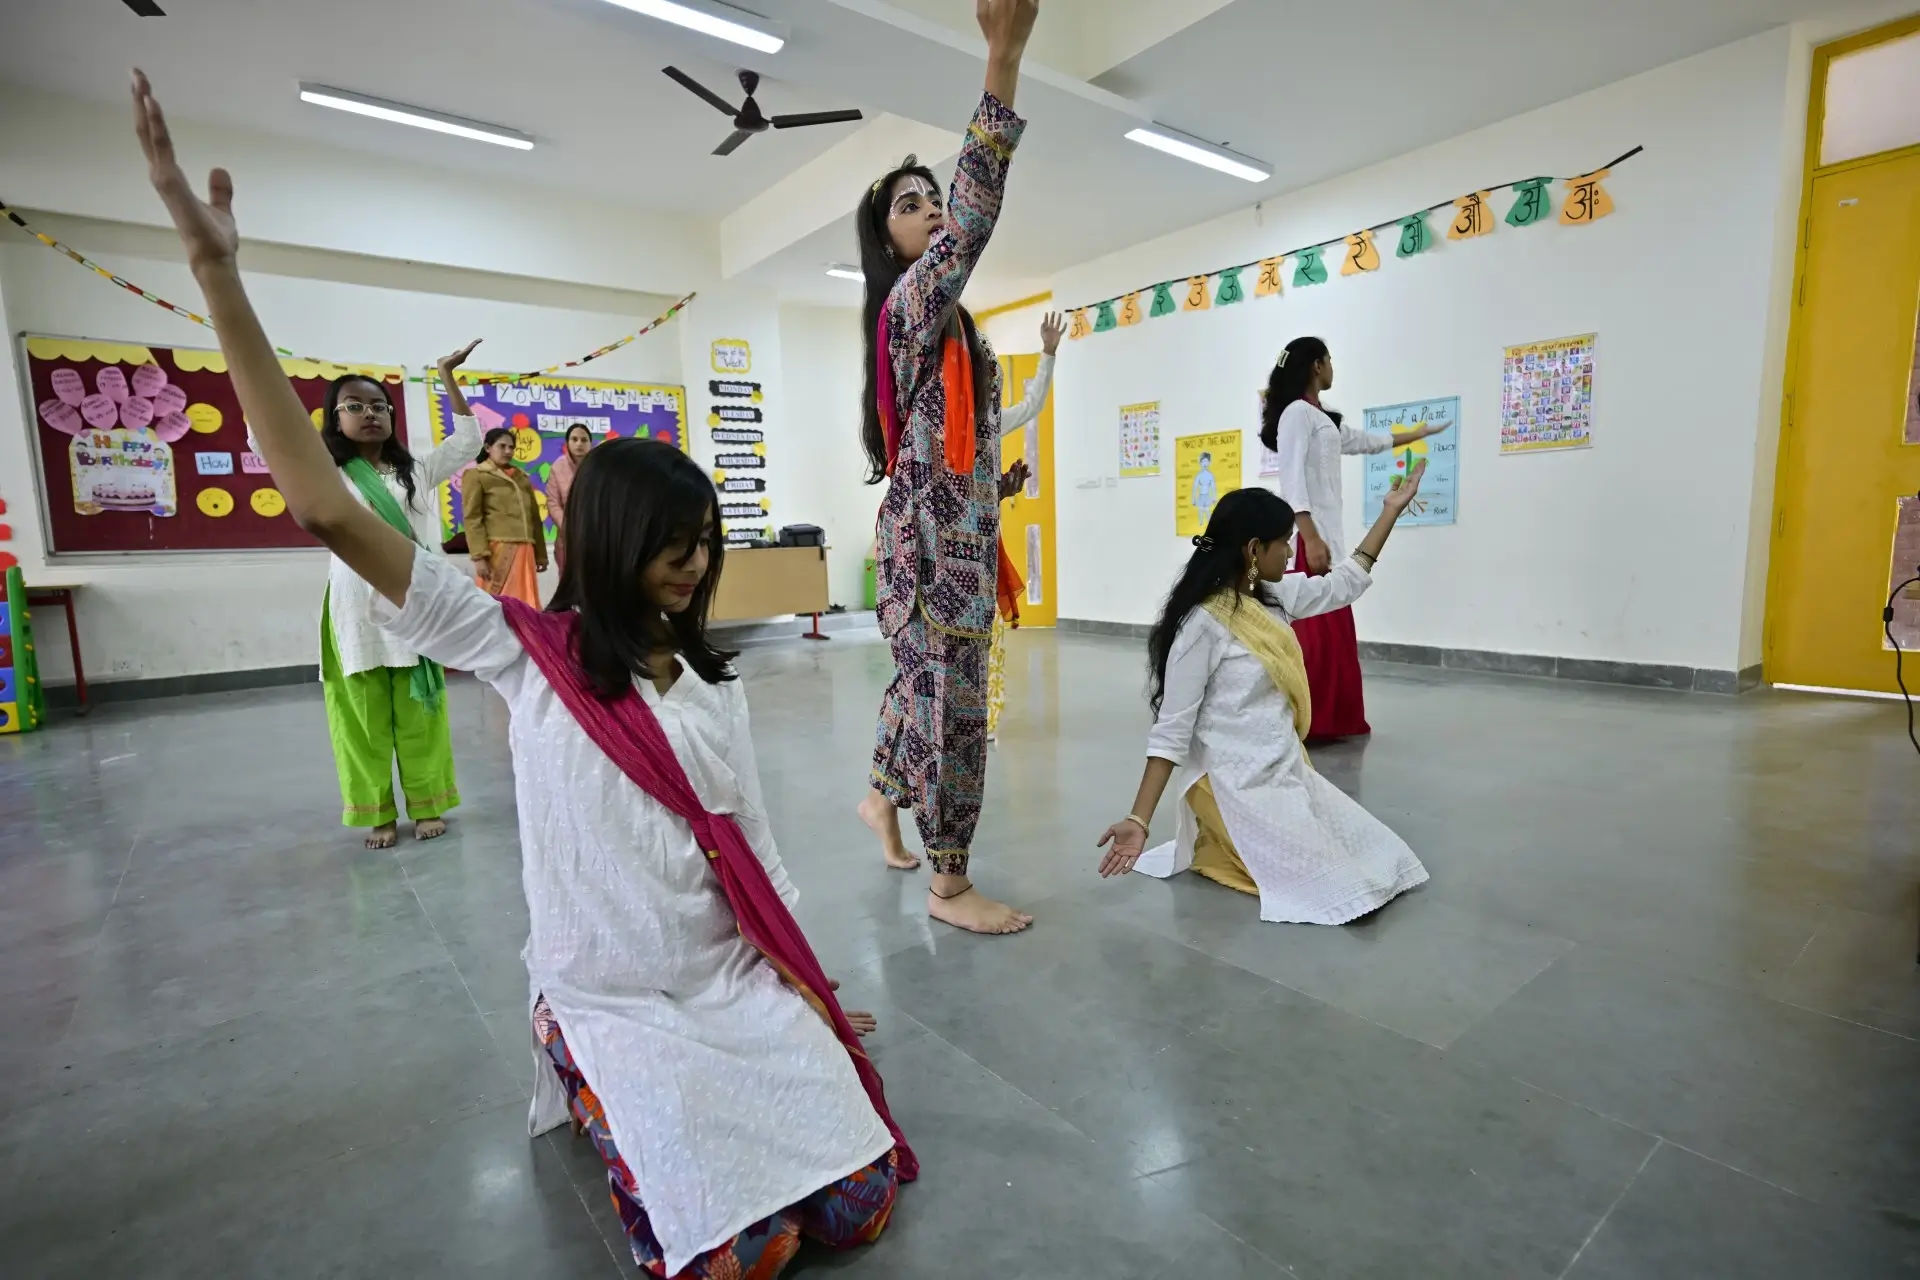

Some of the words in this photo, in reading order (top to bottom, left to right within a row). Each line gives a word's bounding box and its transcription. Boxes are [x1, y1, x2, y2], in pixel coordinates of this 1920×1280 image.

[1188, 282, 1204, 307] उ
[1220, 275, 1238, 301] ऊ
[1514, 181, 1542, 223] अं
[1564, 181, 1600, 220] अः
[720, 385, 751, 393] MONDAY
[500, 385, 558, 408] YOUR
[573, 385, 675, 411] KINDNESS
[721, 410, 753, 418] TUESDAY
[1370, 413, 1392, 428] Parts
[1396, 408, 1407, 424] of
[1411, 415, 1417, 423] a
[1420, 405, 1447, 423] Plant
[714, 432, 760, 440] WEDNESDAY
[93, 434, 151, 452] Happy
[200, 456, 231, 471] How
[721, 456, 758, 464] THURSDAY
[726, 481, 753, 489] FRIDAY
[723, 507, 760, 515] SATURDAY
[729, 532, 758, 540] SUNDAY
